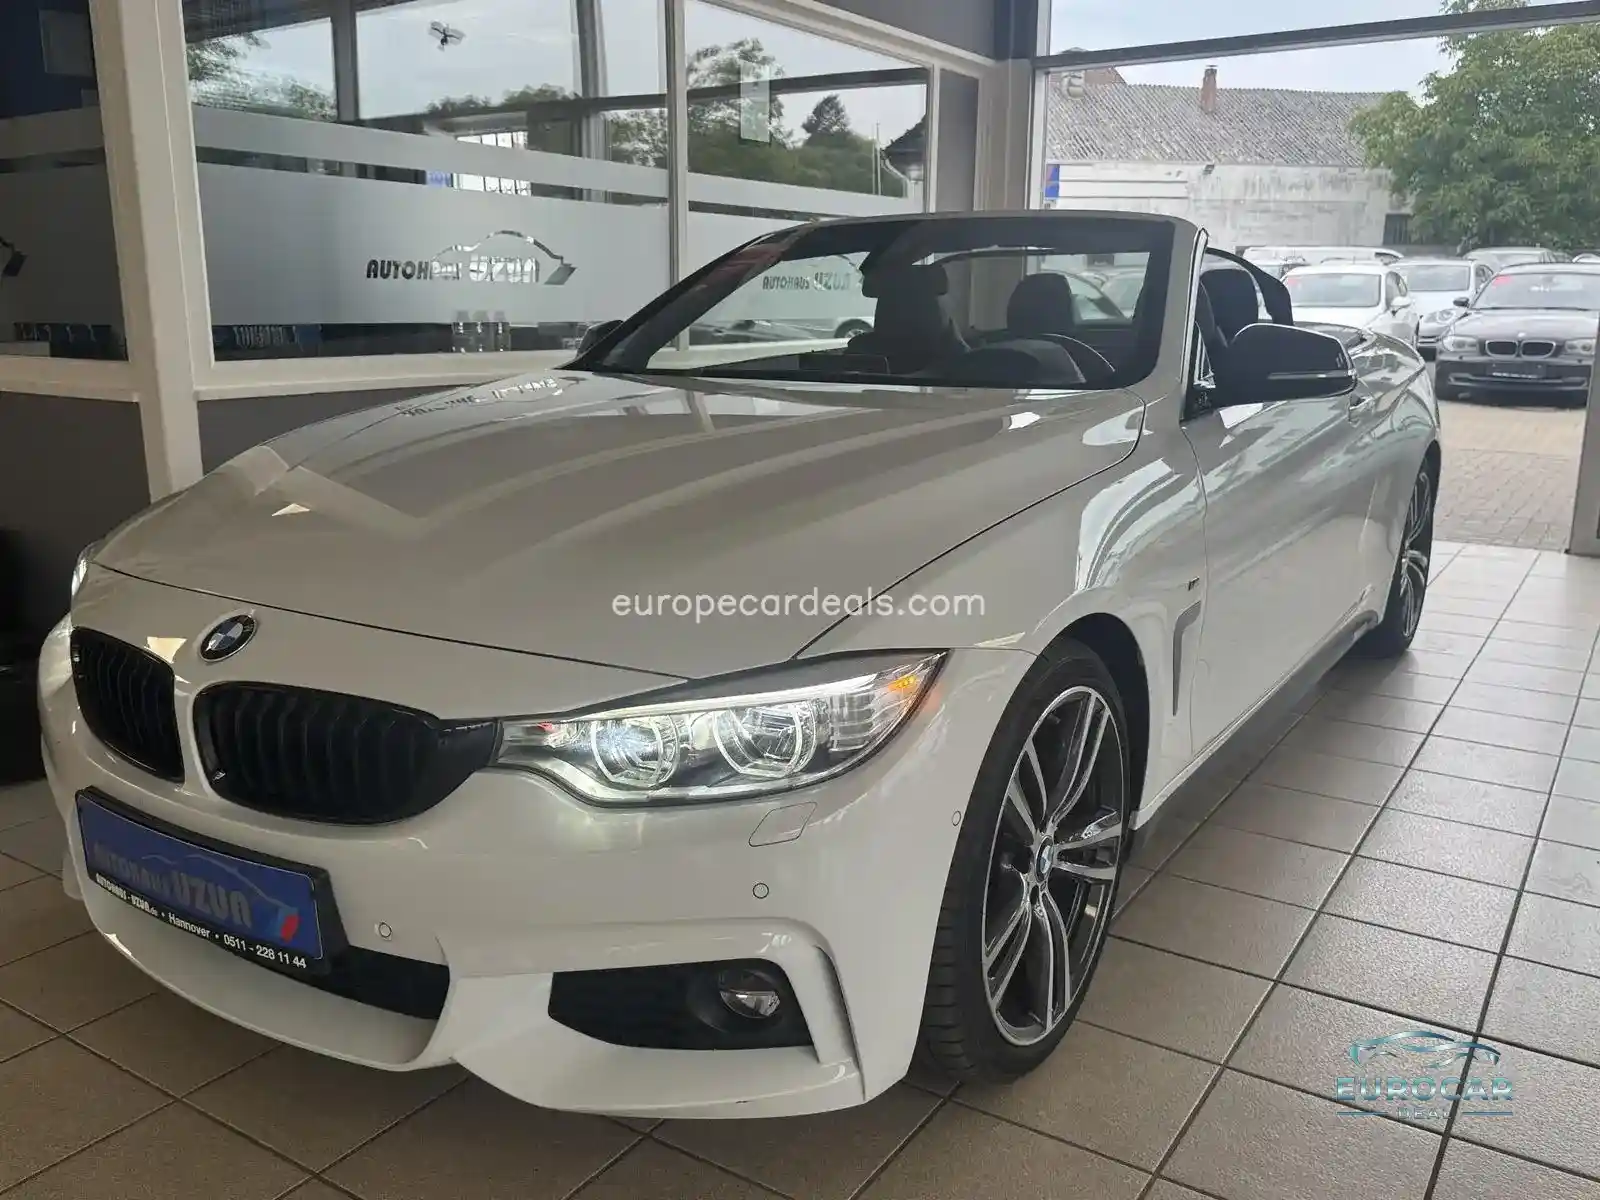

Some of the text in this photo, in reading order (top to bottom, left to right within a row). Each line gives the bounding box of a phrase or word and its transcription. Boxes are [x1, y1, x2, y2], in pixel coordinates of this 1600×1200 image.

[168, 911, 211, 939] Hannover
[223, 933, 246, 951] 0511
[256, 944, 275, 960] 228
[278, 951, 290, 965] 11
[292, 955, 307, 969] 44
